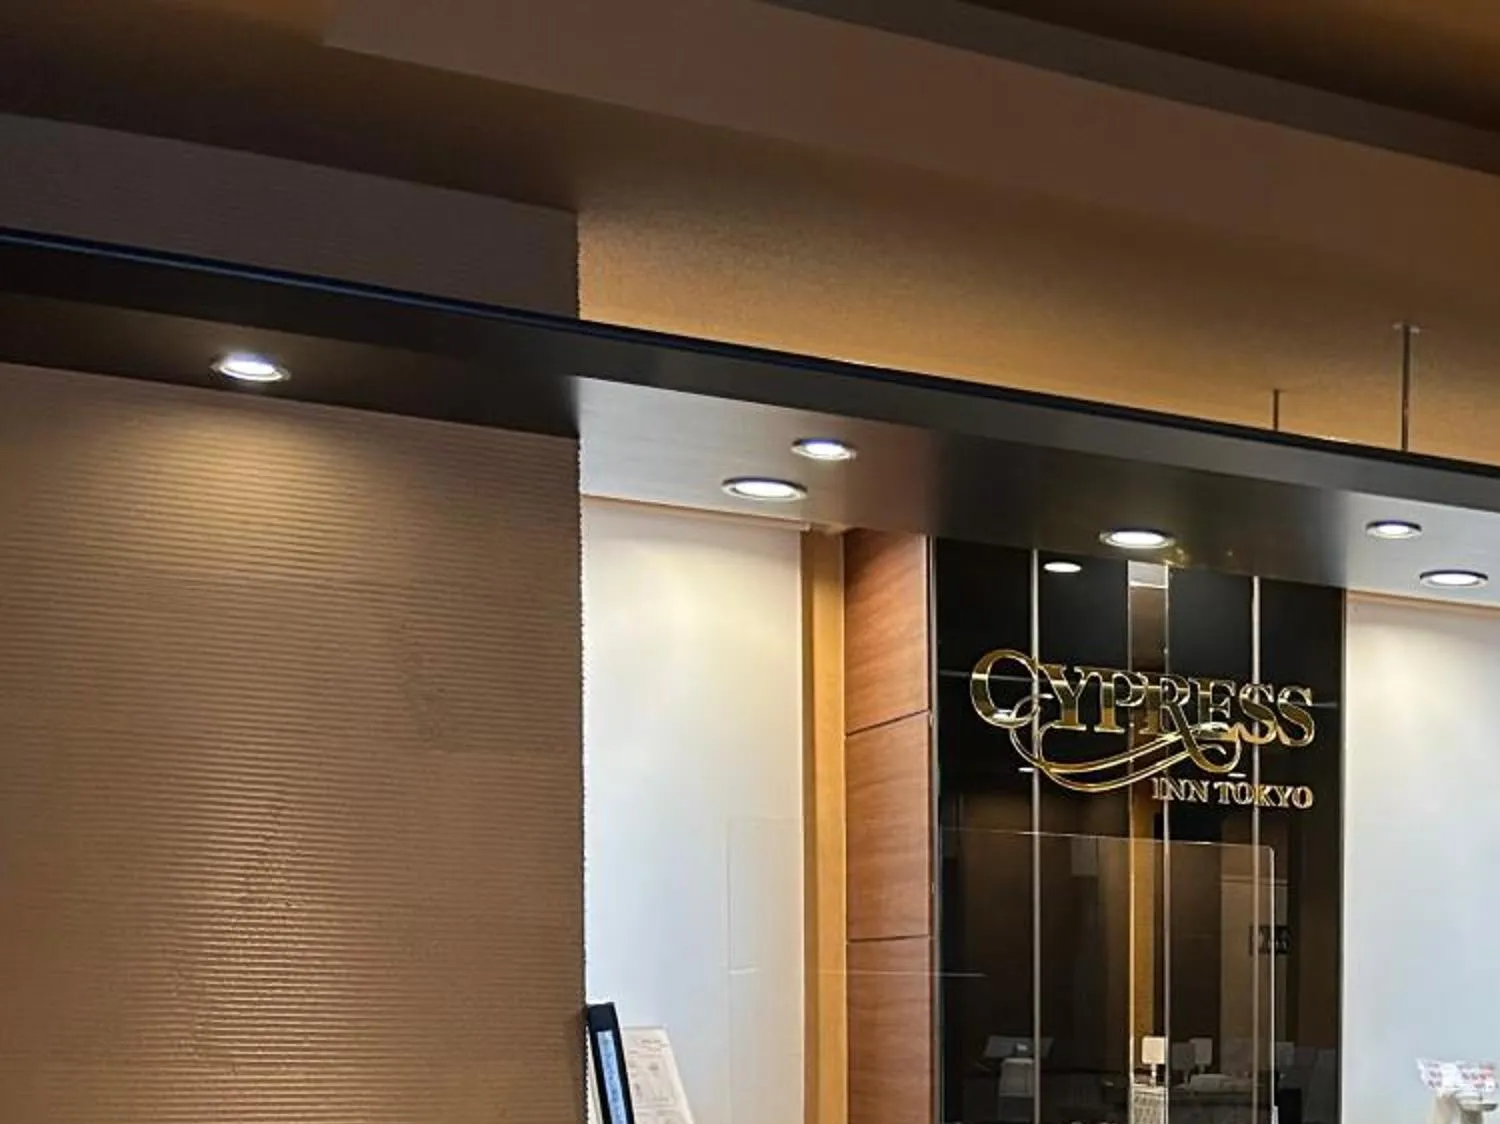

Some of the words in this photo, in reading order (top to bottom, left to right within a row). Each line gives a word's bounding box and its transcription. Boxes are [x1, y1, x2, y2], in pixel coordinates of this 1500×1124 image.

[969, 649, 1316, 775] CYPRESS
[1152, 776, 1209, 805] INN
[1213, 780, 1315, 810] TOKYO
